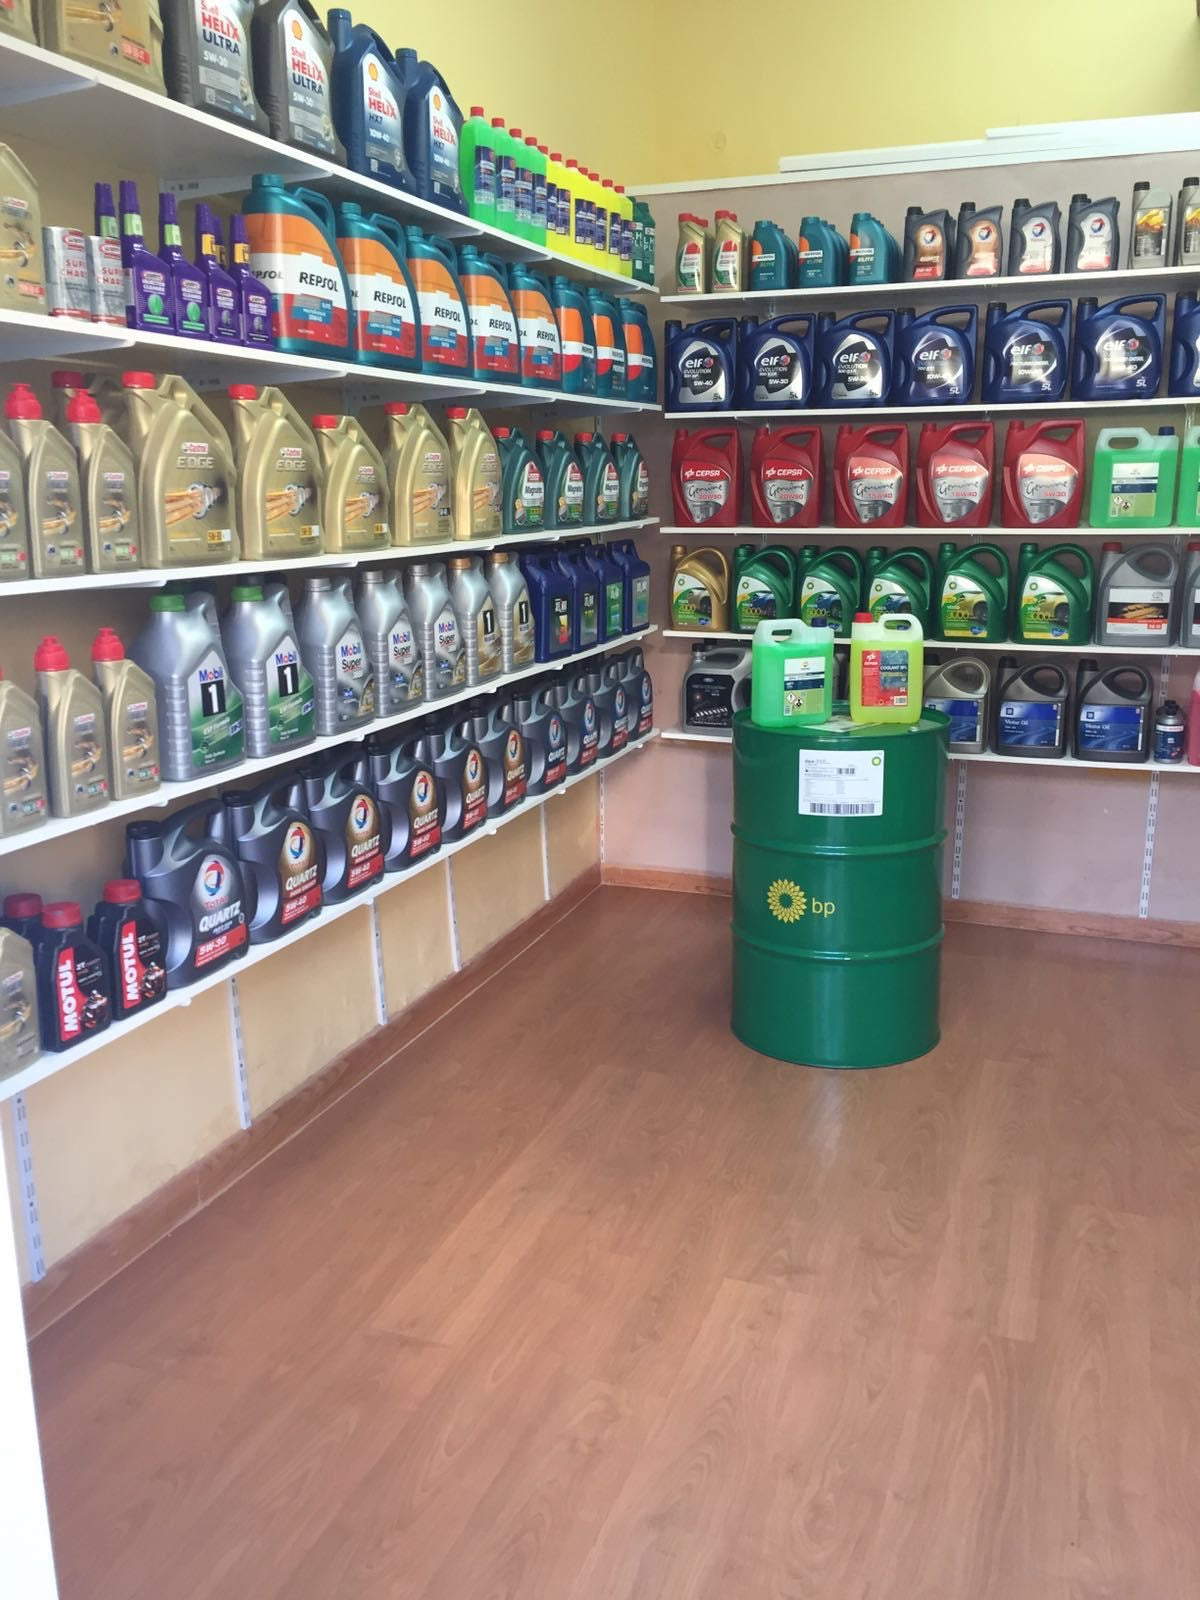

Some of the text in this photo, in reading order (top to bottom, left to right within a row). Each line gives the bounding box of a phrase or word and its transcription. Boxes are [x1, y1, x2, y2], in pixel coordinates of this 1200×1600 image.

[201, 12, 240, 42] HELIX
[202, 29, 241, 56] ULTRA
[291, 58, 324, 84] HELIX
[292, 73, 324, 96] ULTRA
[368, 97, 397, 120] HELIX
[369, 114, 383, 126] HX7
[433, 126, 456, 146] HELIX
[299, 271, 339, 292] REPSOL
[374, 290, 407, 309] REPSOL
[434, 306, 462, 323] REPSOL
[488, 318, 512, 332] REPSOL
[536, 330, 556, 343] REPSOL
[1010, 344, 1032, 355] elf
[1103, 340, 1126, 351] elf
[760, 356, 780, 366] elf
[840, 352, 859, 363] elf
[920, 350, 940, 360] elf
[685, 358, 704, 368] elf
[950, 386, 960, 394] 5L
[1041, 382, 1052, 390] 5L
[176, 456, 214, 469] EDGE
[276, 460, 307, 472] EDGE
[948, 464, 978, 473] CEPSA
[1036, 464, 1066, 472] CEPSA
[695, 469, 721, 477] CEPSA
[776, 468, 803, 476] CEPSA
[864, 467, 892, 476] CEPSA
[524, 486, 542, 496] Magnatec
[688, 484, 723, 498] Genuine
[768, 484, 805, 498] Genuine
[856, 482, 894, 497] Genuine
[940, 480, 980, 496] Genuine
[1026, 480, 1068, 496] Genuine
[522, 602, 527, 622] 1
[438, 622, 455, 634] Mobil
[486, 612, 492, 632] 1
[392, 632, 410, 646] Mobil
[438, 634, 456, 646] Super
[340, 644, 361, 658] Mobil
[394, 645, 412, 658] Super
[276, 652, 298, 666] Mobil
[342, 658, 362, 671] Super
[200, 667, 223, 682] Mobil
[284, 666, 292, 694] 1
[208, 684, 219, 714] 1
[507, 764, 524, 780] QUARTZ
[466, 784, 486, 803] QUARTZ
[414, 808, 438, 828] QUARTZ
[352, 835, 380, 858] QUARTZ
[286, 864, 318, 890] QUARTZ
[205, 894, 228, 910] TOTAL
[812, 898, 836, 918] bp
[198, 900, 241, 932] QUARTZ
[198, 936, 228, 955] 5W-30
[122, 932, 139, 1000] MOTUL
[58, 960, 78, 1032] MOTUL
